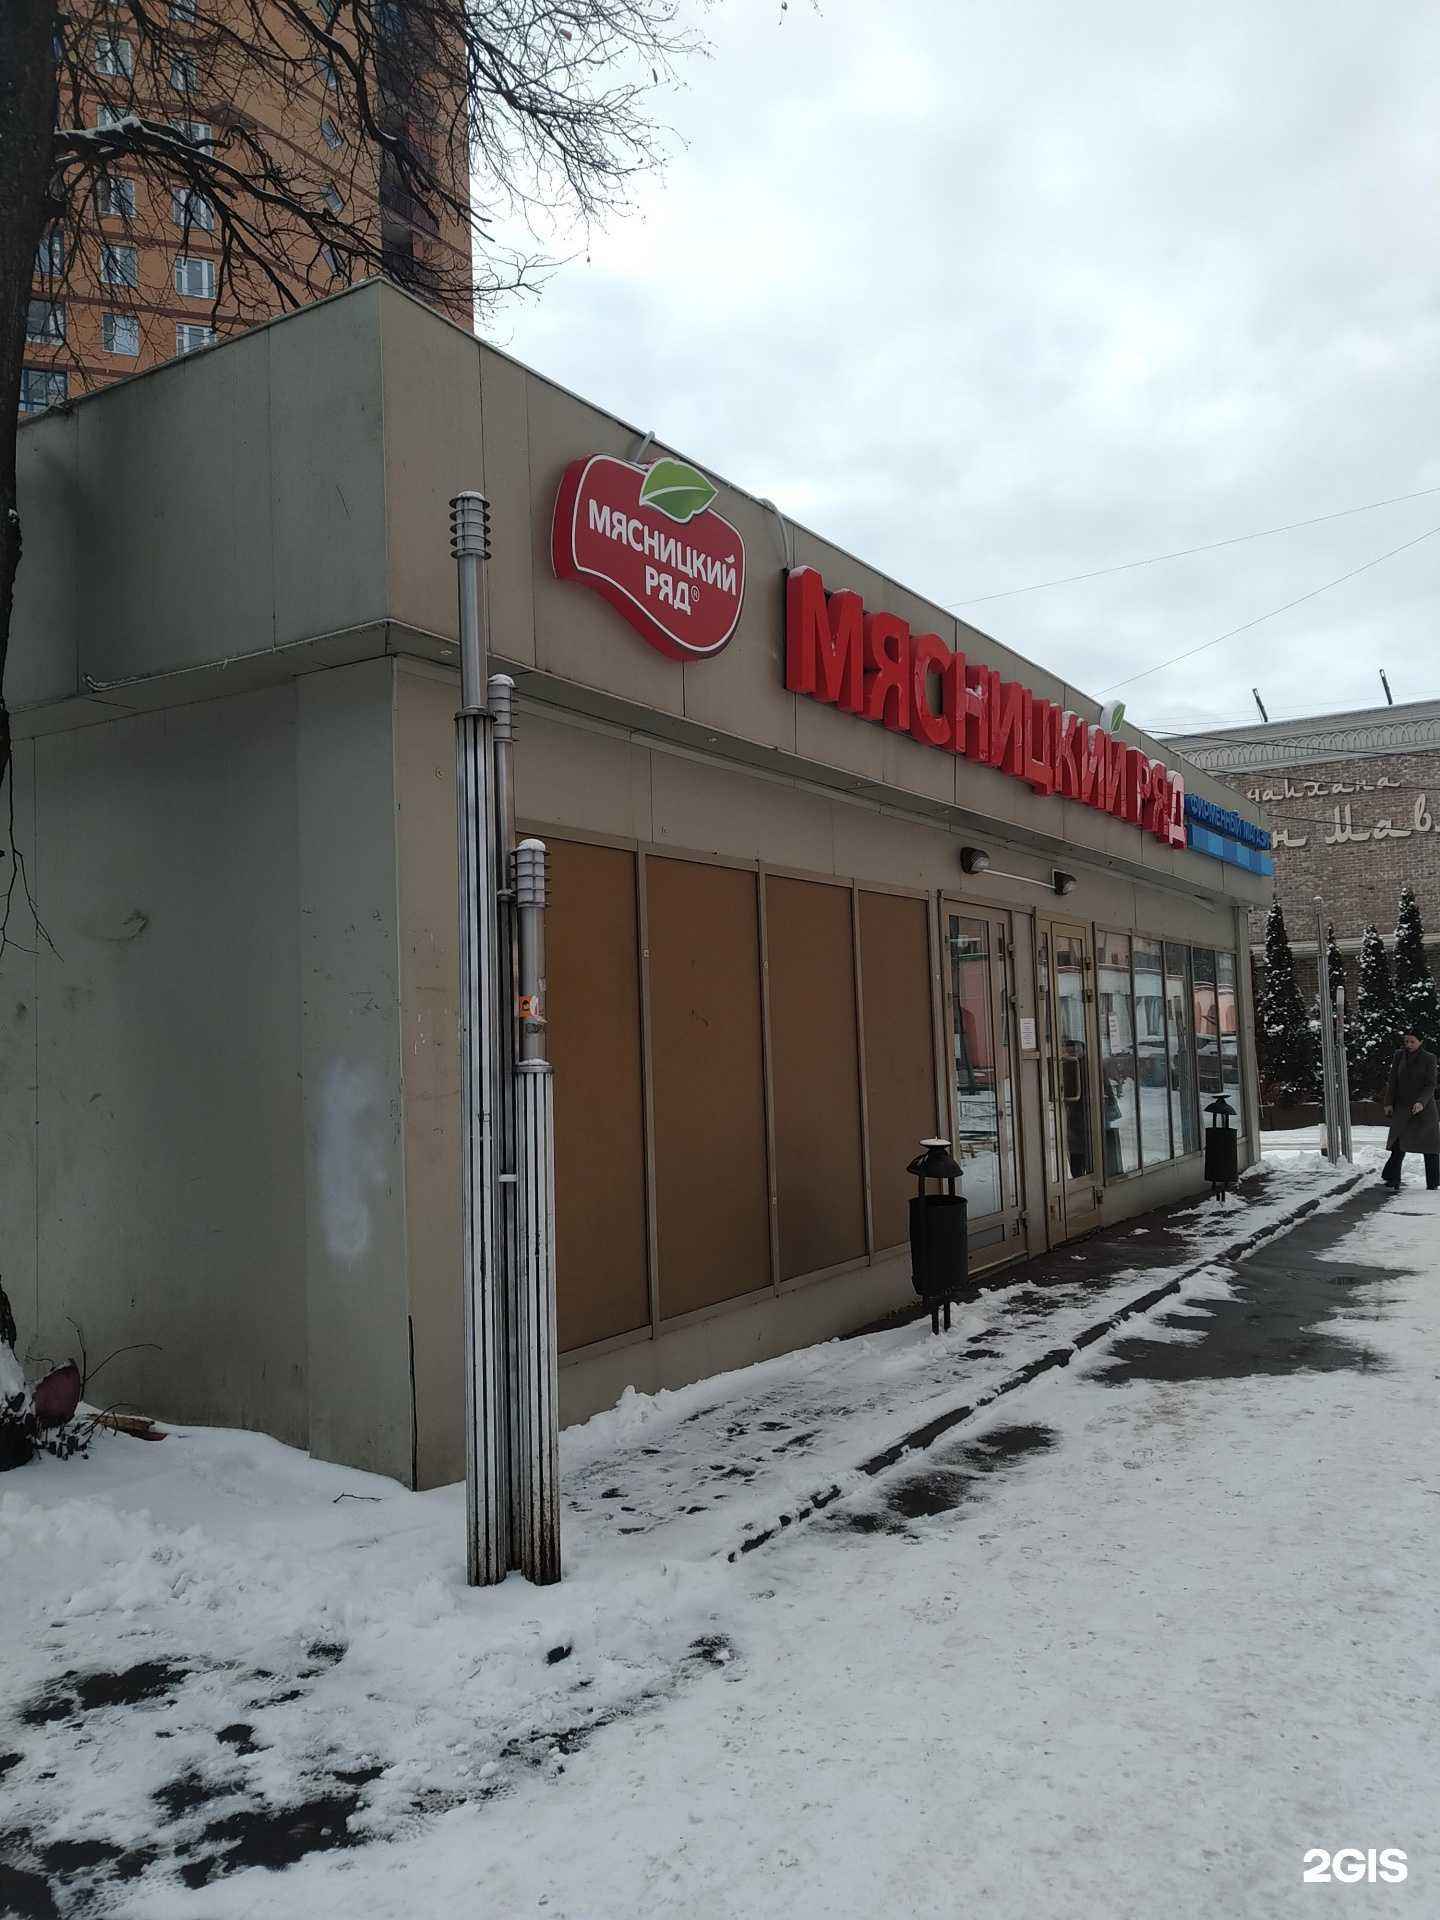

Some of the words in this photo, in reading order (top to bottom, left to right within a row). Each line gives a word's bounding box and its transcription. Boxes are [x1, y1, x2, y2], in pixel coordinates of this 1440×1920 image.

[588, 498, 737, 596] МЯСНИЦКИЙ
[1126, 746, 1187, 849] РЯД
[1325, 793, 1440, 844] Мав
